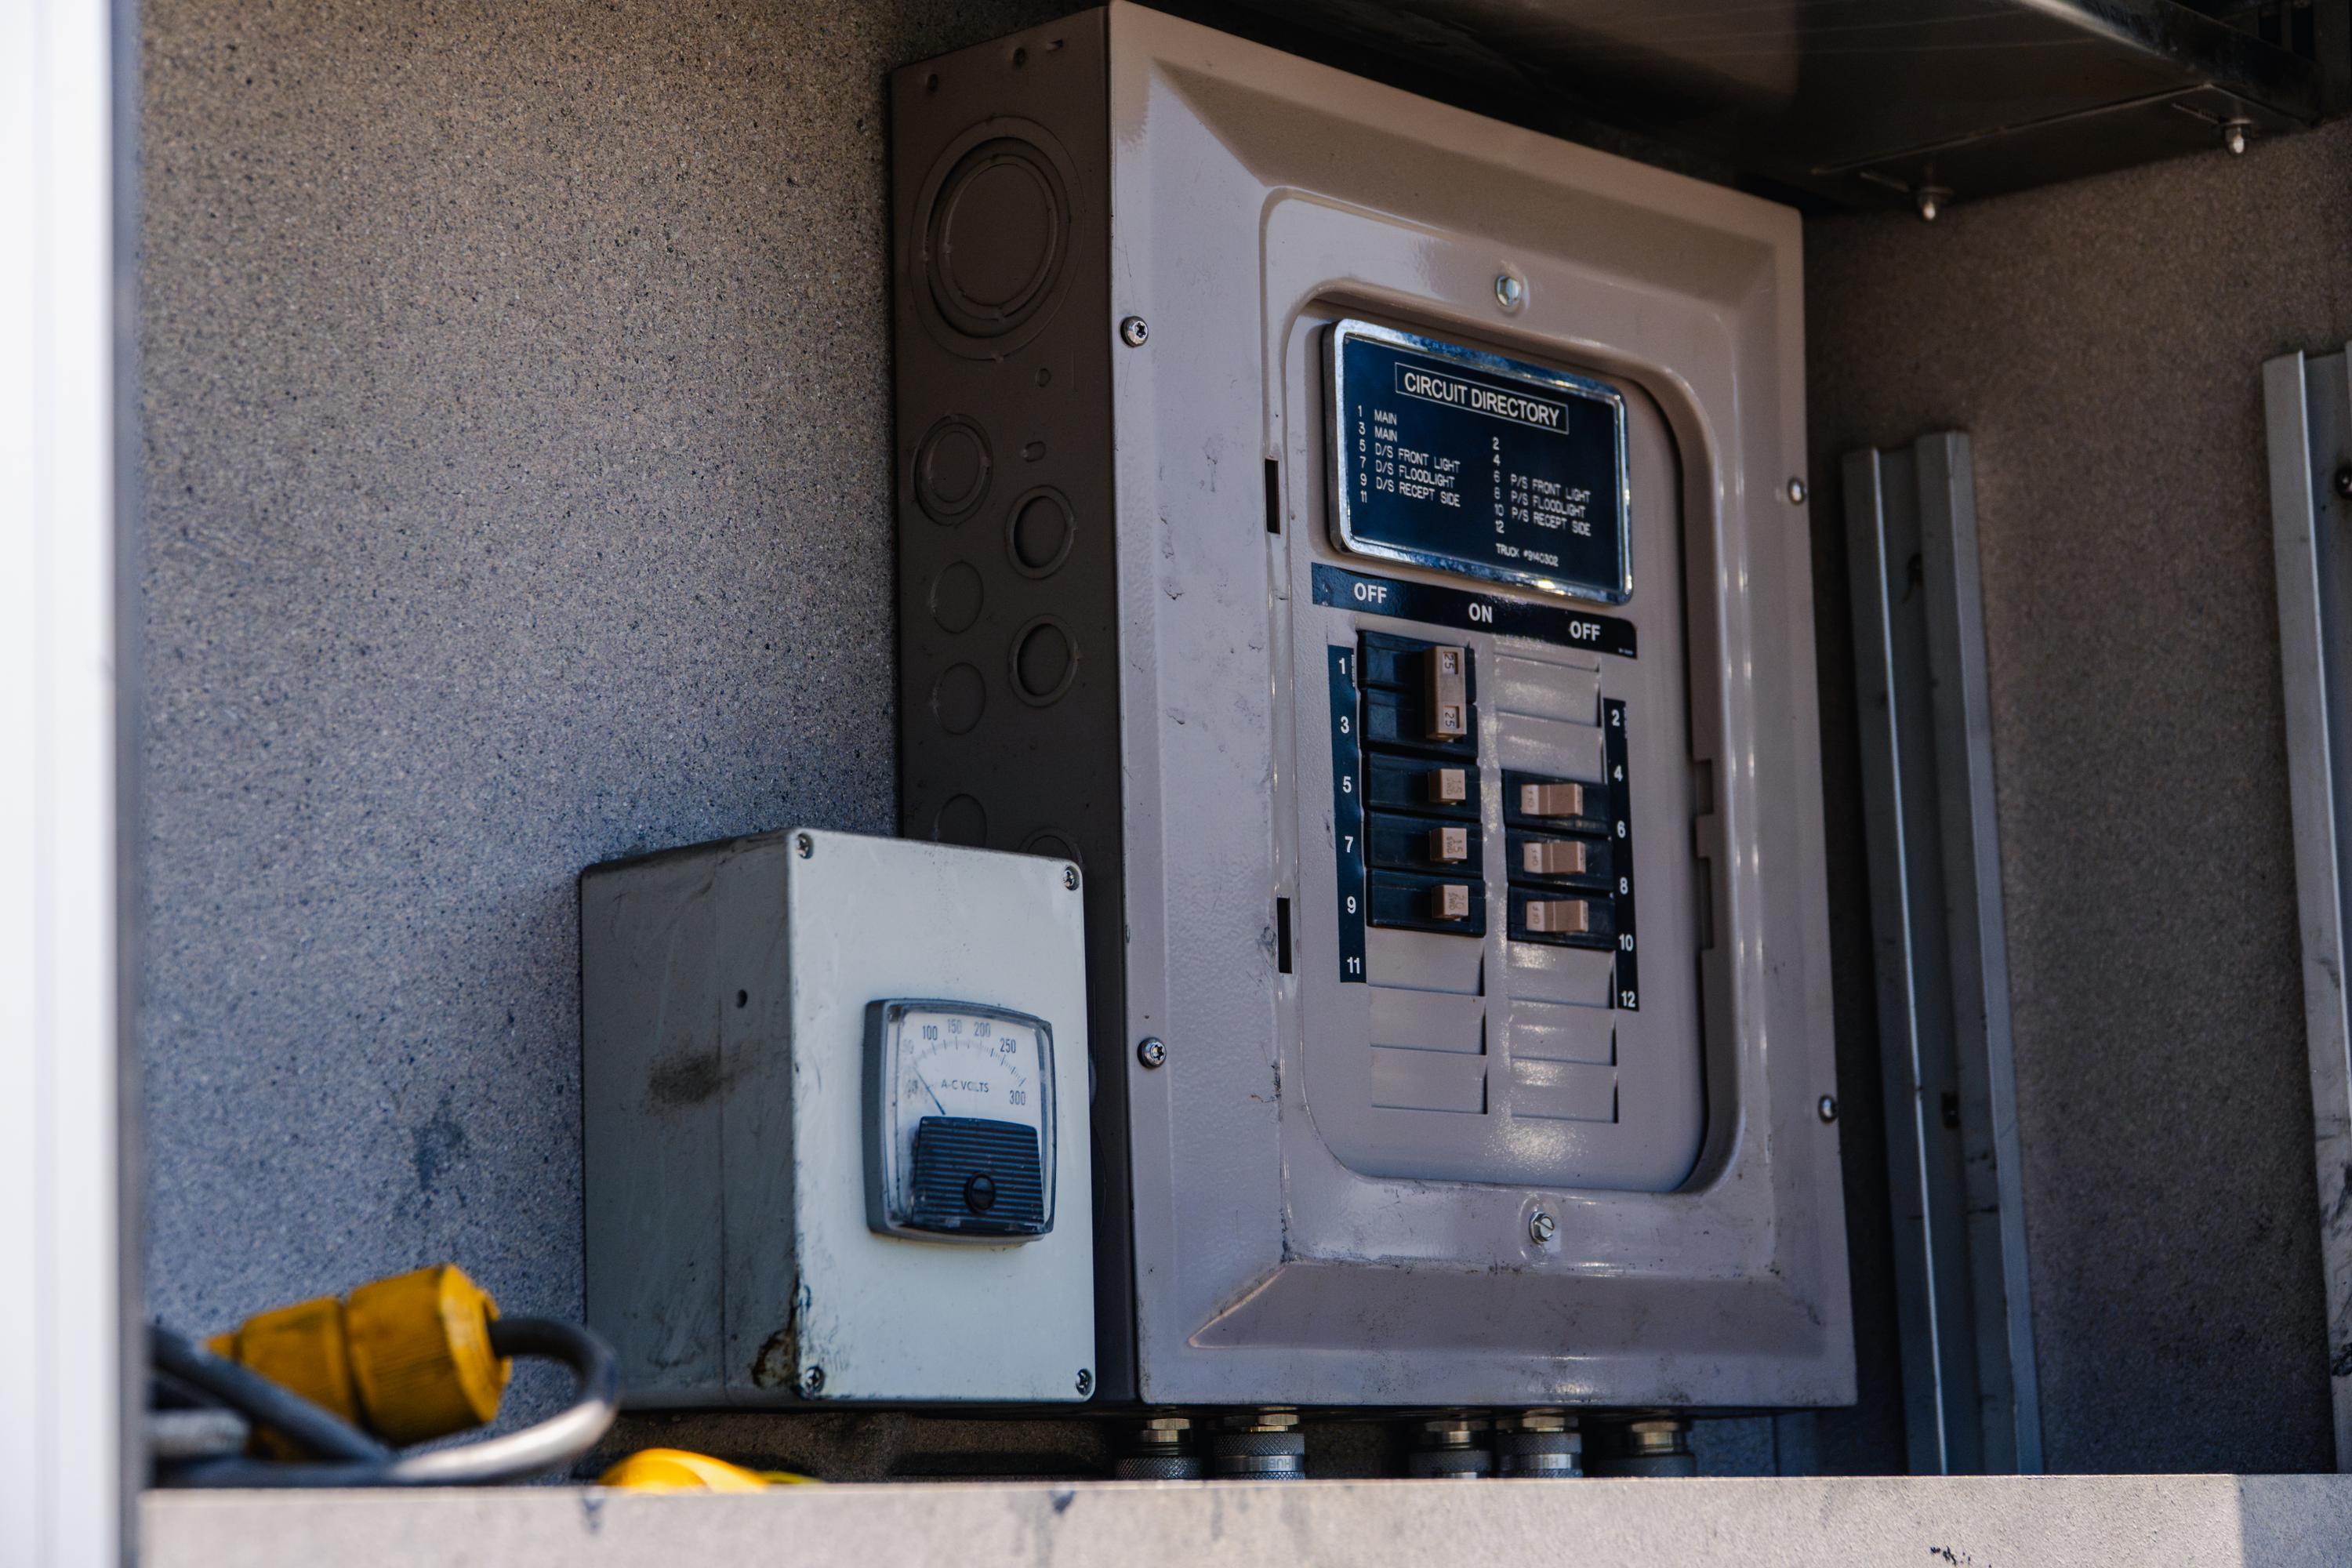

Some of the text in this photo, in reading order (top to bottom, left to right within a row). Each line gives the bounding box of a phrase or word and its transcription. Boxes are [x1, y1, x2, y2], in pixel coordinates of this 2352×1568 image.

[1403, 372, 1559, 427] CIRCUIT DIRECTORY
[1357, 405, 1397, 425] 1 MAIN
[1358, 422, 1398, 442] 3 MAIN
[1492, 437, 1500, 450] 2
[1359, 439, 1461, 474] 5 D/S FRONT LIGHT
[1493, 454, 1501, 466] 4
[1359, 456, 1455, 488] 7 D/S FLOODLIGHT
[1359, 473, 1461, 507] 9 D/S RECEPT SIDE
[1494, 470, 1592, 503] 6 P/S FRONT LIGHT
[1360, 490, 1367, 503] 11
[1494, 487, 1586, 518] 8 P/S FLOODLIGHT
[1494, 503, 1592, 537] 10 P/S RECEPT SIDE
[1495, 520, 1504, 534] 12
[1495, 543, 1520, 558] TRUCK
[1353, 582, 1601, 641] OFF ON OFF
[1338, 657, 1346, 674] 1
[1444, 654, 1454, 670] 25
[1340, 716, 1349, 734] 3
[1445, 711, 1455, 728] 25
[1611, 709, 1621, 727] 2
[1613, 764, 1623, 782] 4
[1342, 775, 1352, 793] 5
[1617, 820, 1626, 838] 6
[1345, 836, 1354, 853] 7
[1454, 840, 1463, 853] 15
[1620, 877, 1628, 895] 8
[1347, 896, 1356, 914] 9
[1454, 894, 1465, 909] 20
[1619, 934, 1634, 951] 10
[1346, 956, 1360, 975] 11
[1621, 990, 1636, 1008] 12
[922, 1025, 938, 1040] 100
[947, 1018, 962, 1034] 150
[974, 1022, 991, 1037] 200
[1000, 1037, 1016, 1054] 250
[1009, 1090, 1026, 1105] 300
